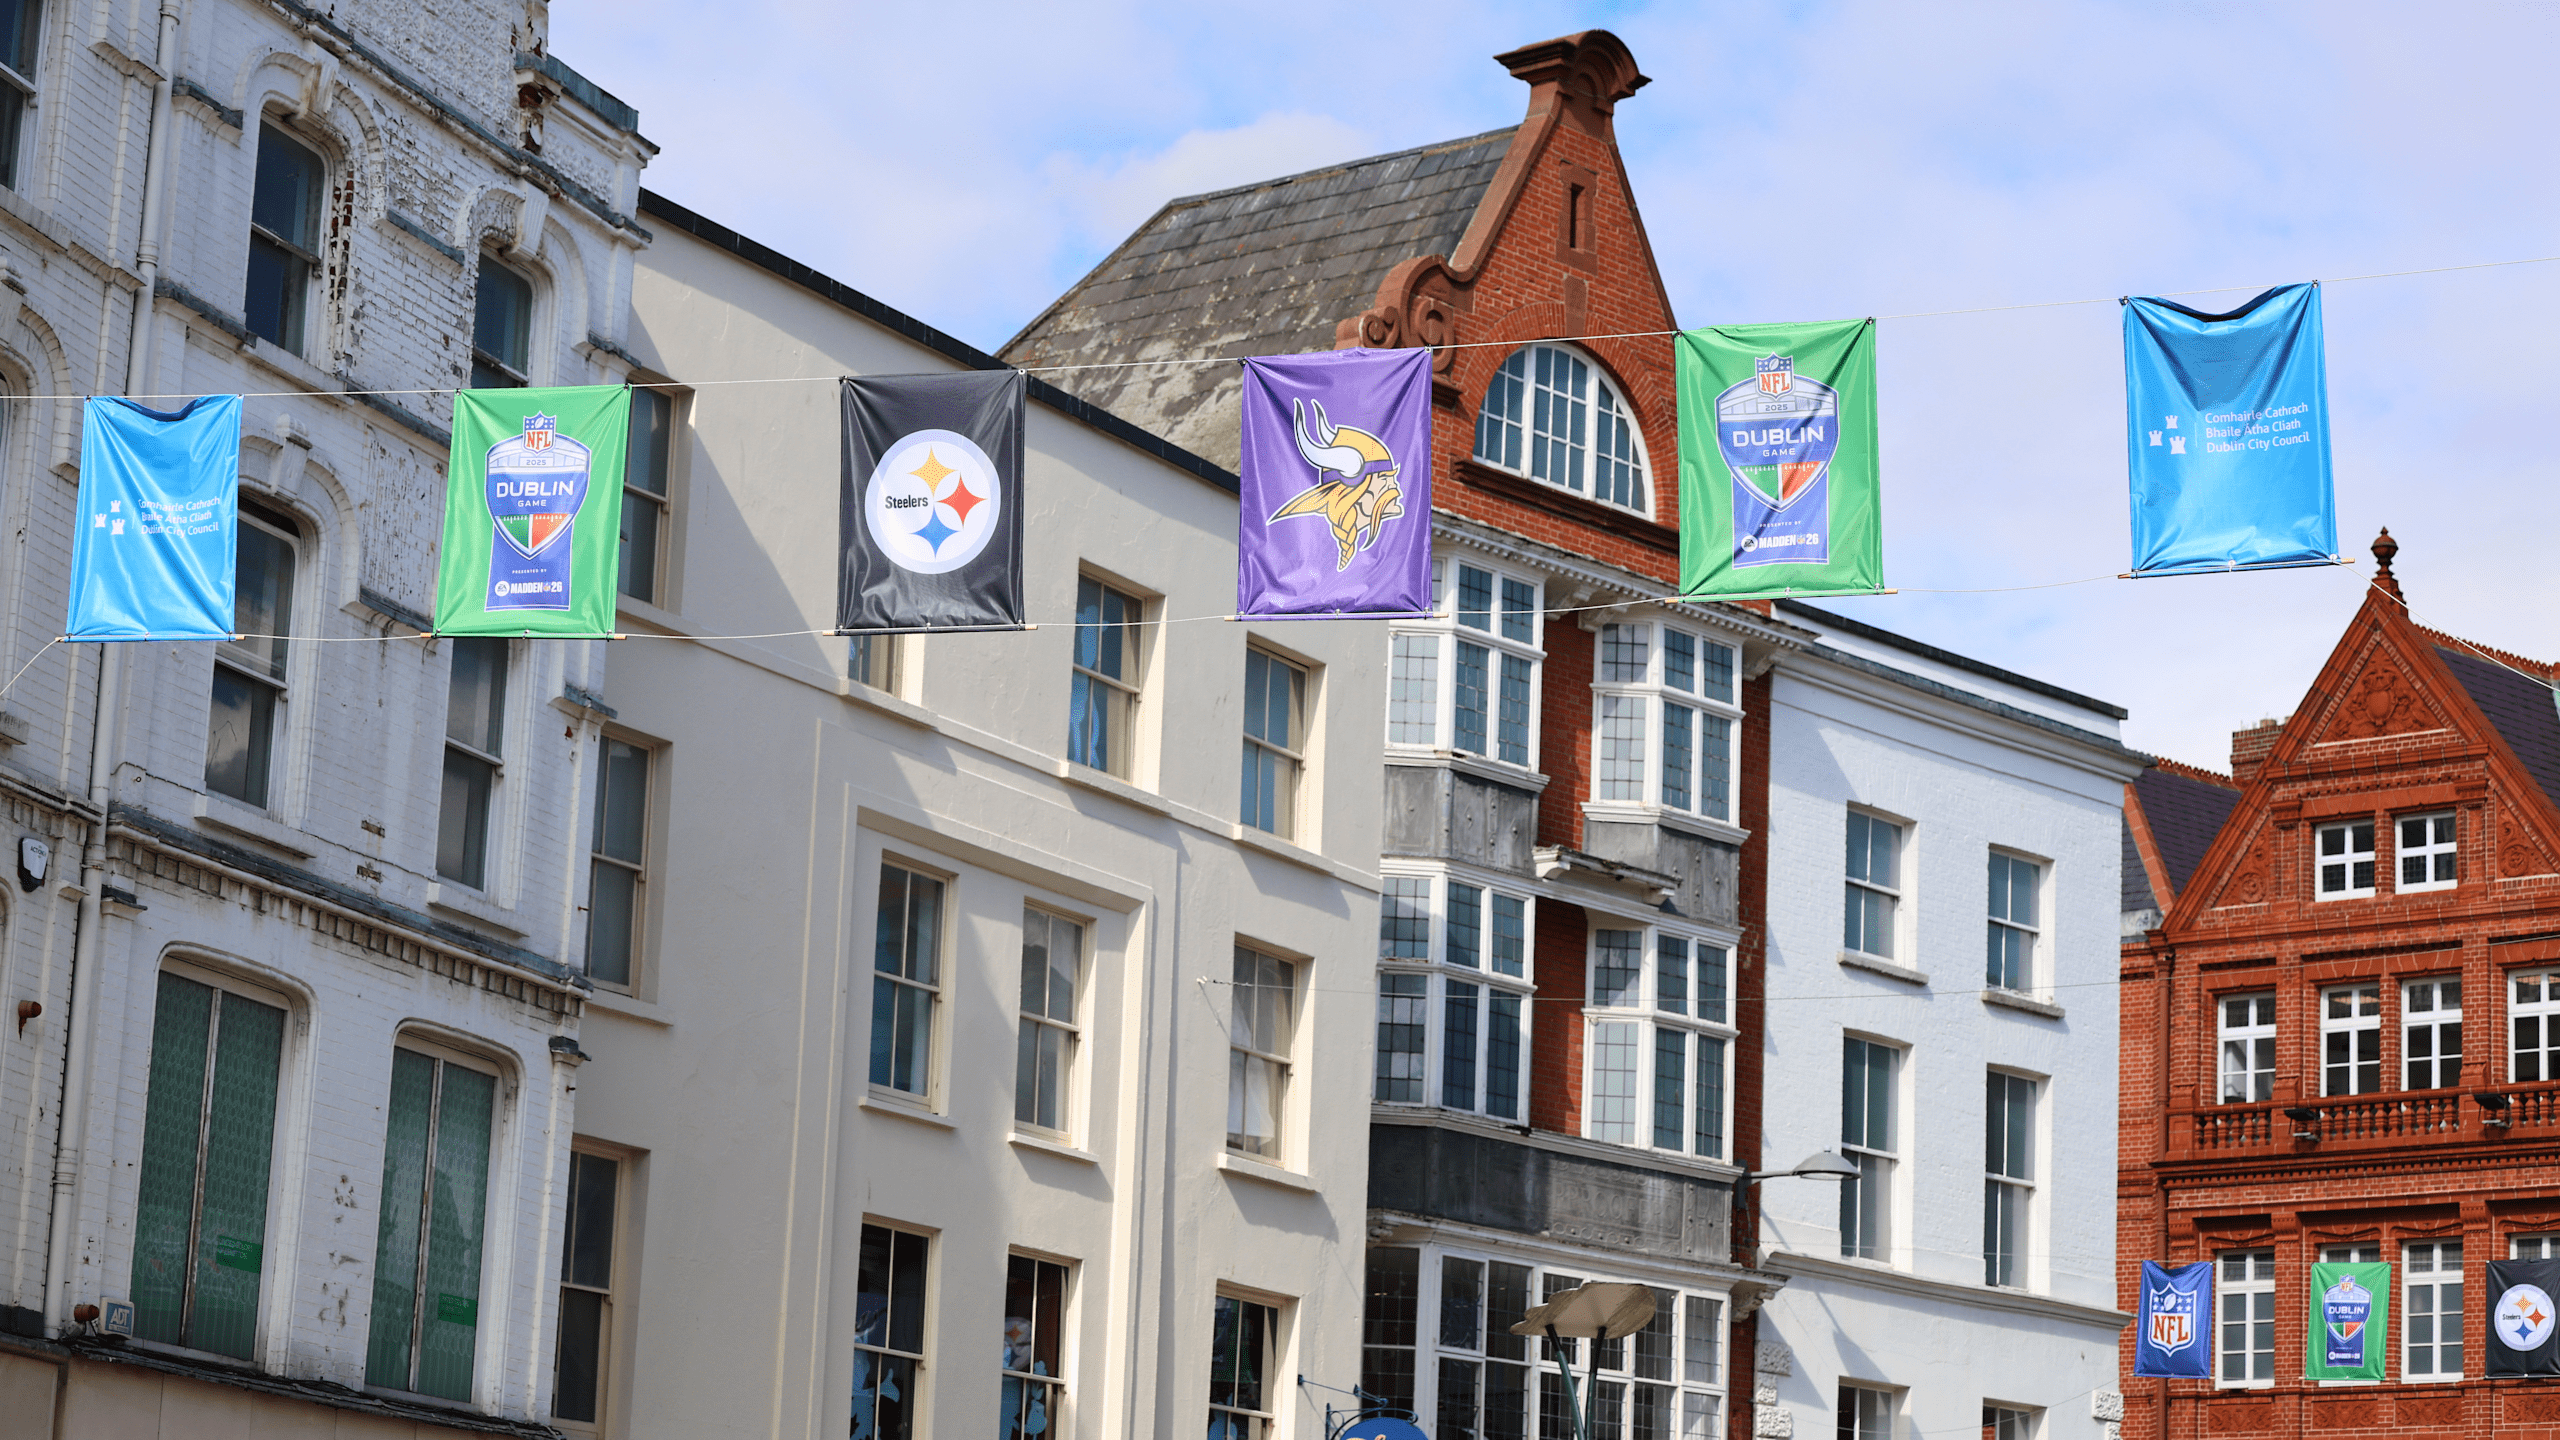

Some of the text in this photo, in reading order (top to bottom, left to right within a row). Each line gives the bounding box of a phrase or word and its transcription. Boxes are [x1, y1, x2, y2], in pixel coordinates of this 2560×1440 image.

[1760, 372, 1790, 394] NFL
[1765, 403, 1788, 411] 2025
[2205, 402, 2308, 424] Comhairle Cathrach
[1732, 426, 1824, 447] DUBLIN
[2206, 425, 2241, 438] Bhaile
[2272, 419, 2301, 432] Cliath
[526, 430, 551, 450] NFL
[2206, 431, 2310, 453] Dublin City Council
[1762, 448, 1796, 457] GAME
[496, 480, 574, 498] DUBLIN
[186, 496, 220, 511] Cathrach
[884, 494, 928, 509] Steelers
[189, 510, 212, 523] Cliath
[165, 526, 186, 539] City
[188, 522, 219, 536] Council
[1759, 534, 1796, 549] MADDEN
[1806, 533, 1819, 545] 26
[510, 582, 543, 594] MADDEN
[551, 581, 562, 593] 26
[110, 1307, 130, 1326] ADT
[2328, 1306, 2365, 1315] DUBLIN
[2153, 1315, 2189, 1345] NFL
